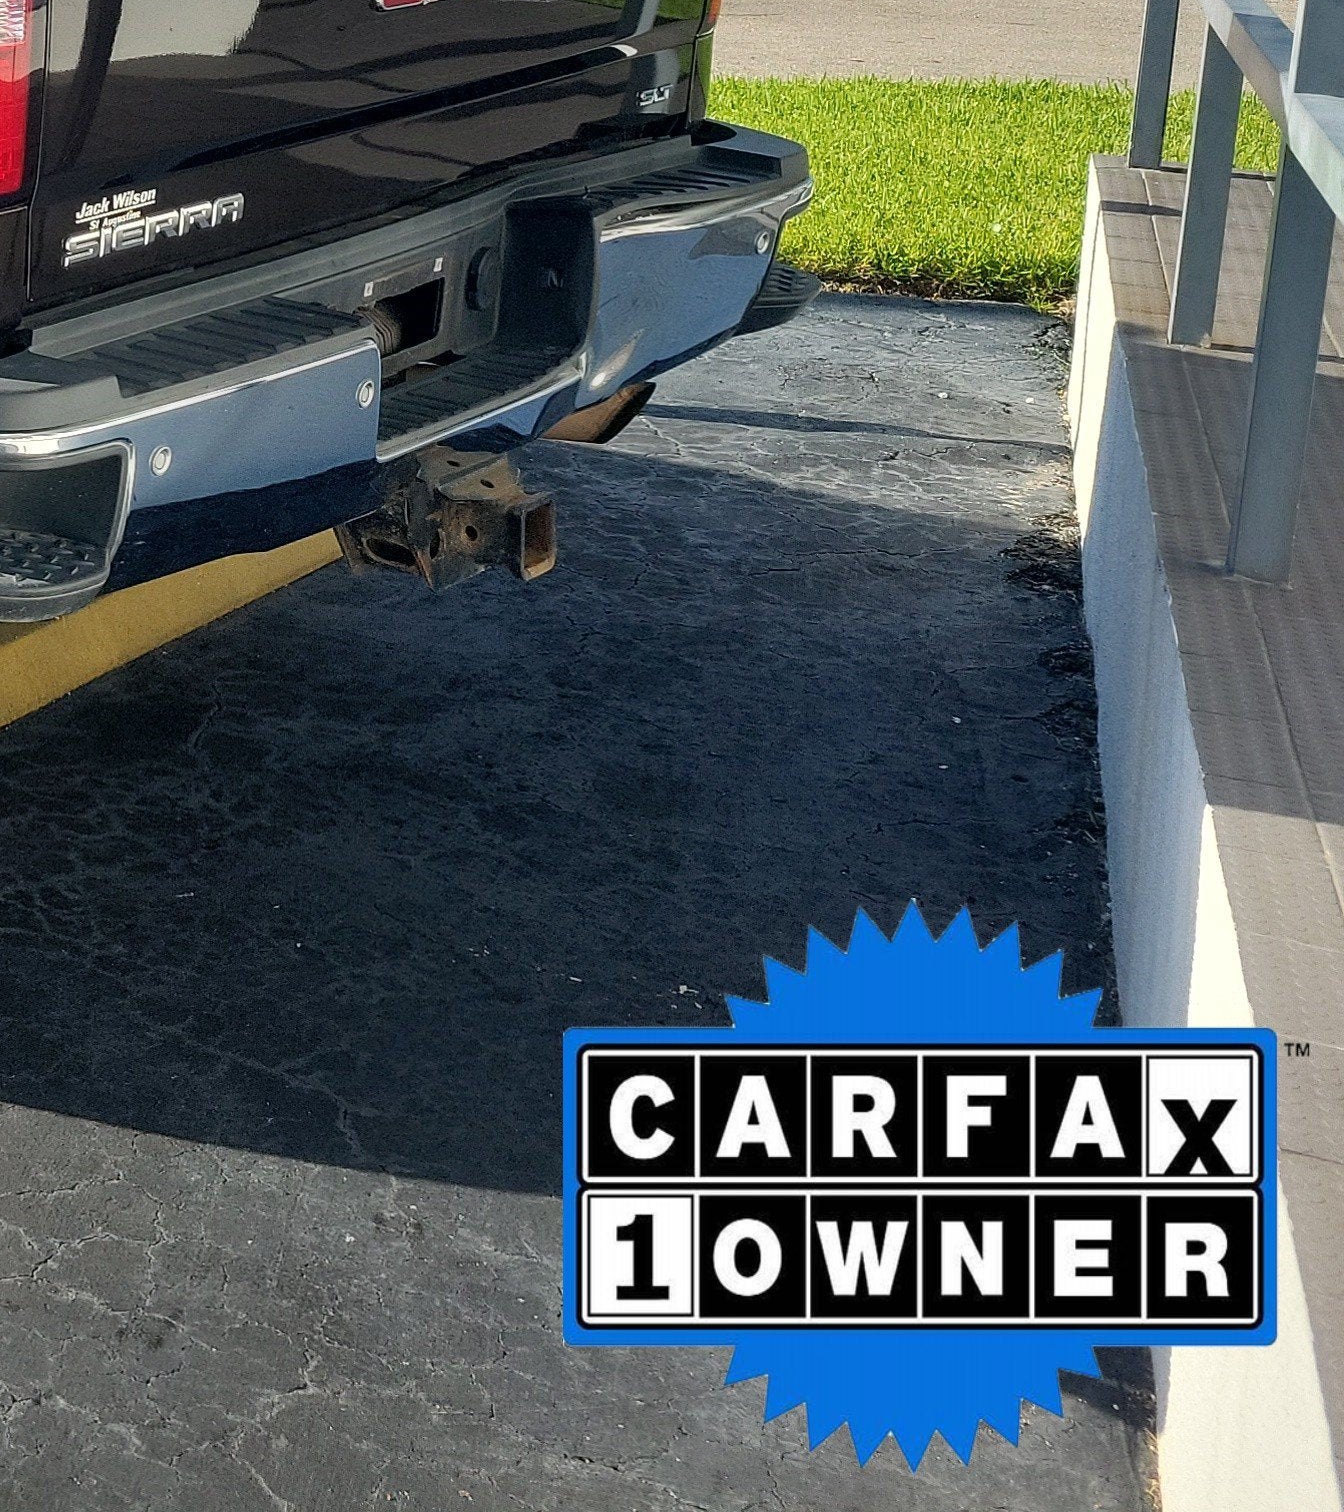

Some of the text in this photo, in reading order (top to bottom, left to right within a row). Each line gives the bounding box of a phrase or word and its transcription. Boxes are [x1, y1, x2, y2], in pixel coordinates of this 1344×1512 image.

[639, 84, 673, 106] SLT
[75, 189, 157, 220] Jack Wilson
[63, 193, 245, 268] SIERRA
[102, 209, 142, 229] Augustine
